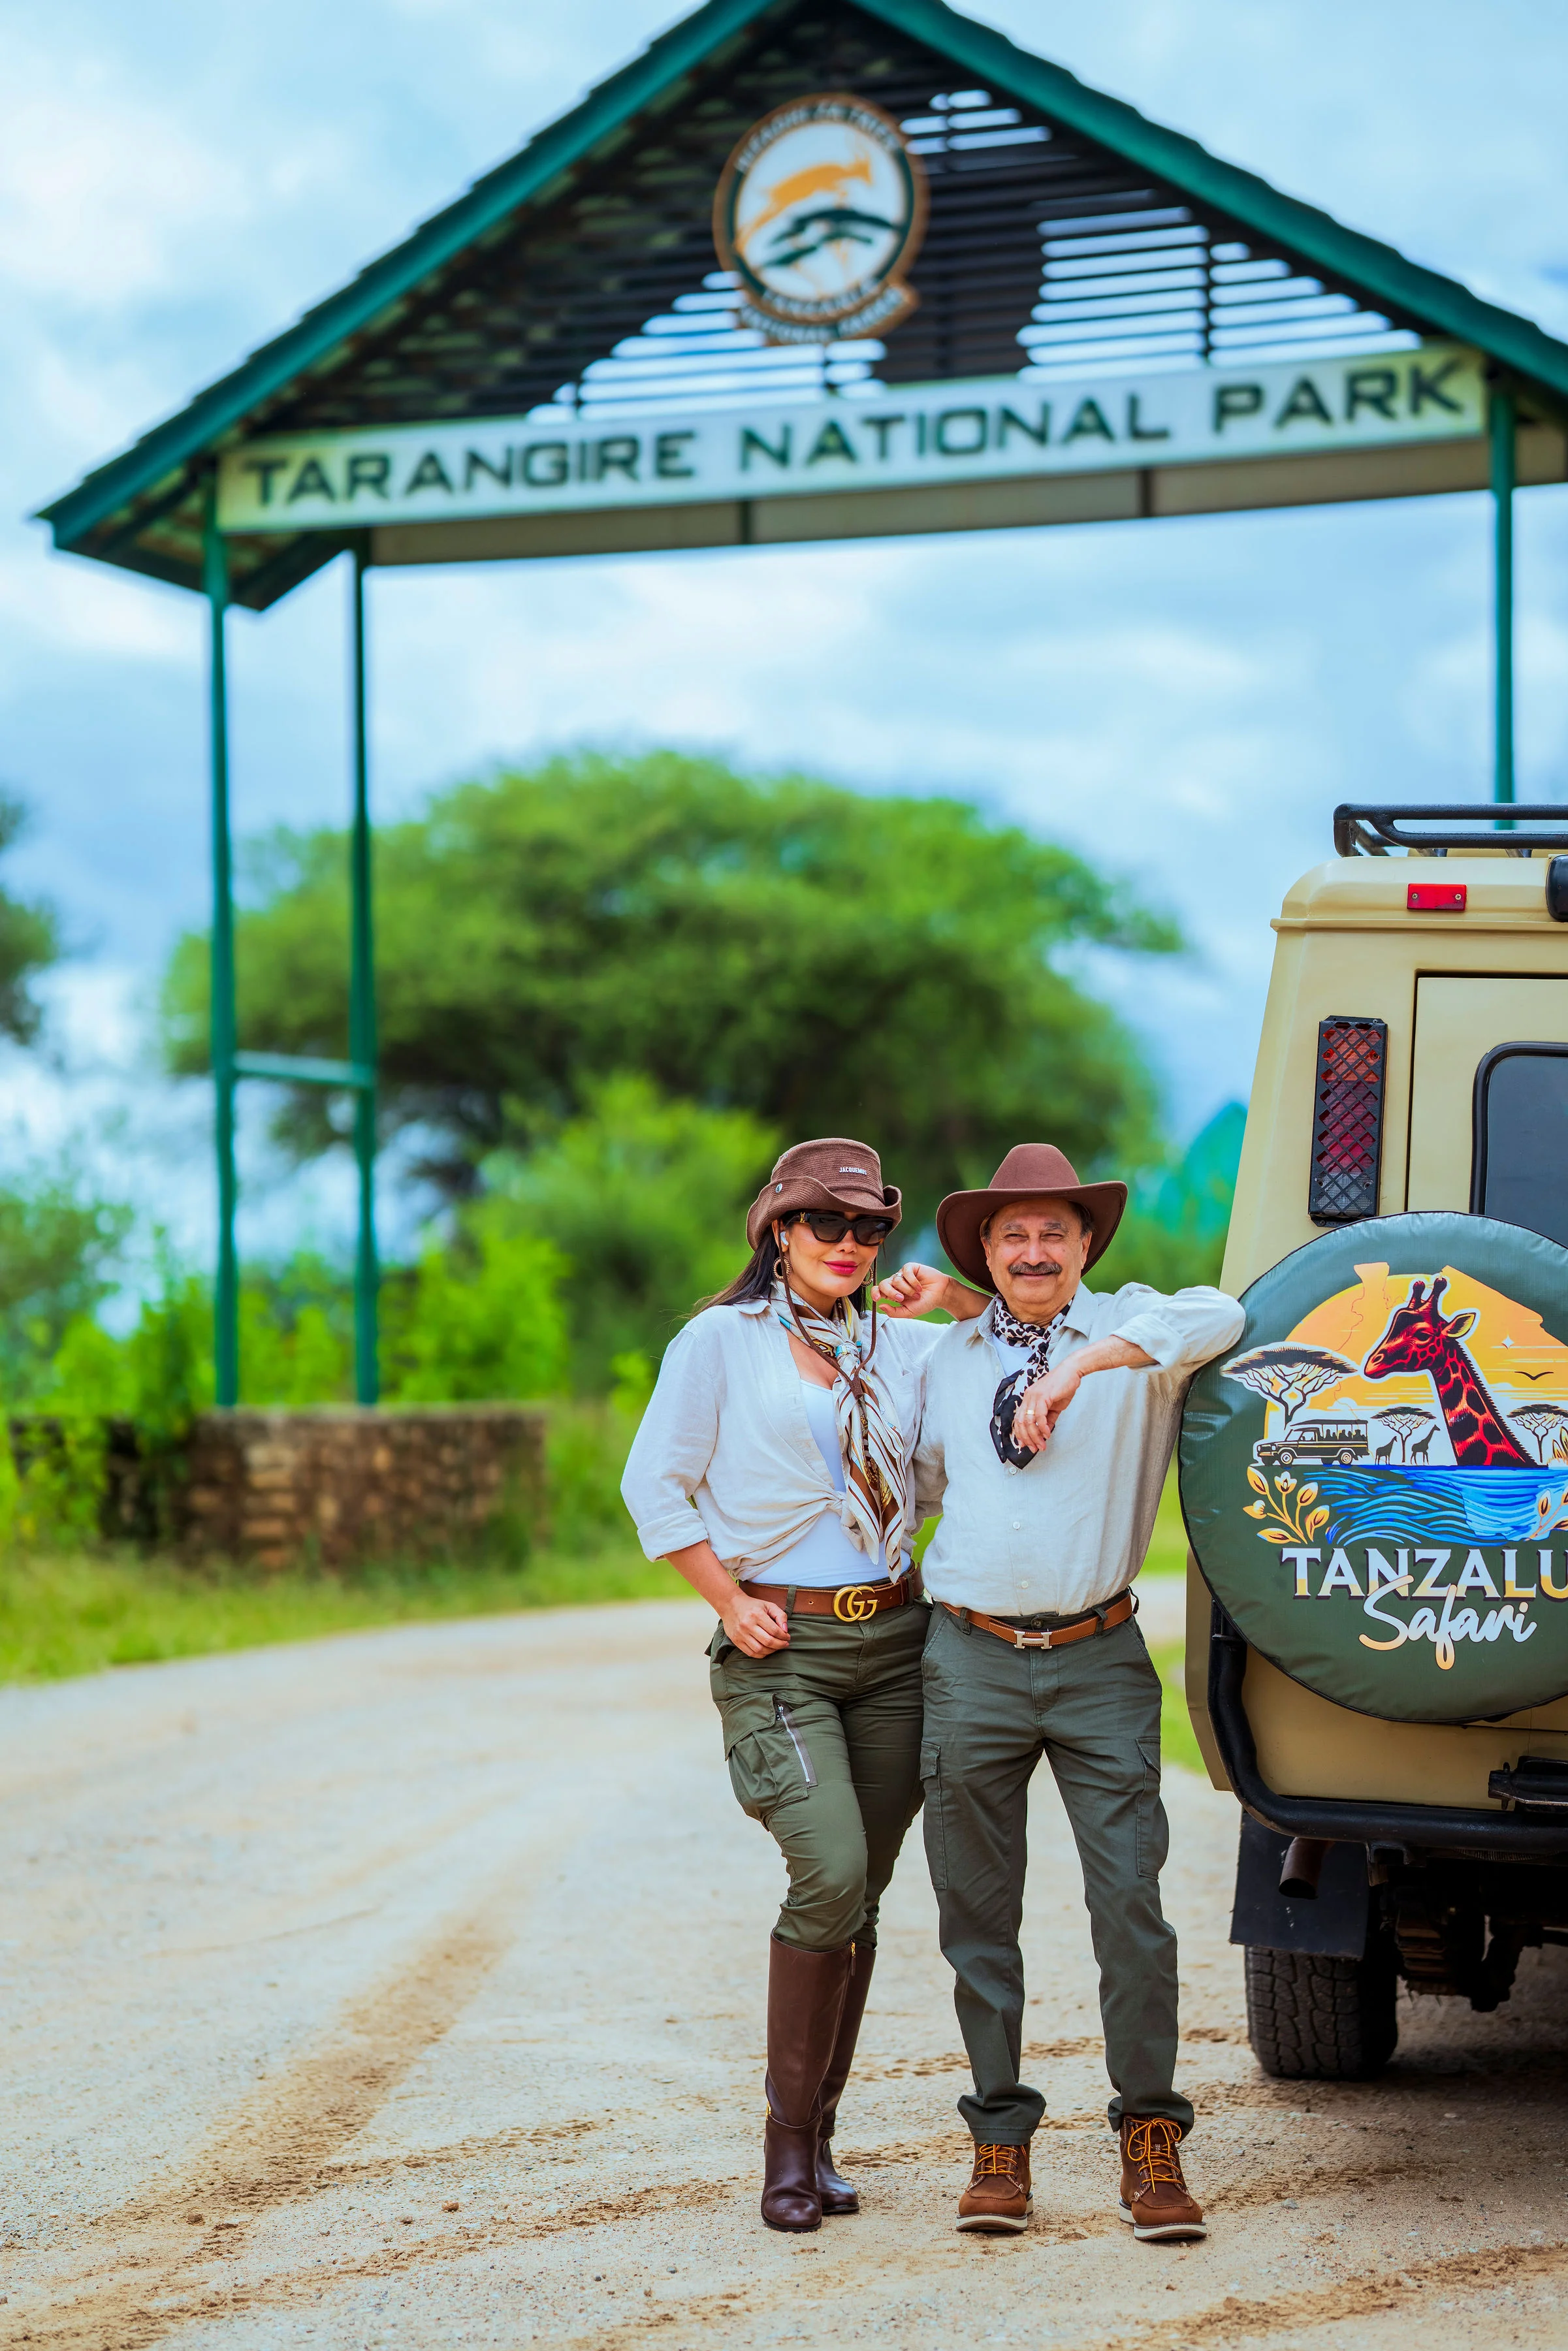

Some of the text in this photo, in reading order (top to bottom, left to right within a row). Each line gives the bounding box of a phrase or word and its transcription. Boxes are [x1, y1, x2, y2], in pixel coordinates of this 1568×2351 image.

[242, 357, 1464, 507] TARANGIRE NATIONAL PARK
[839, 1166, 867, 1176] JACQUEMUS
[1358, 1575, 1537, 1671] Safari
